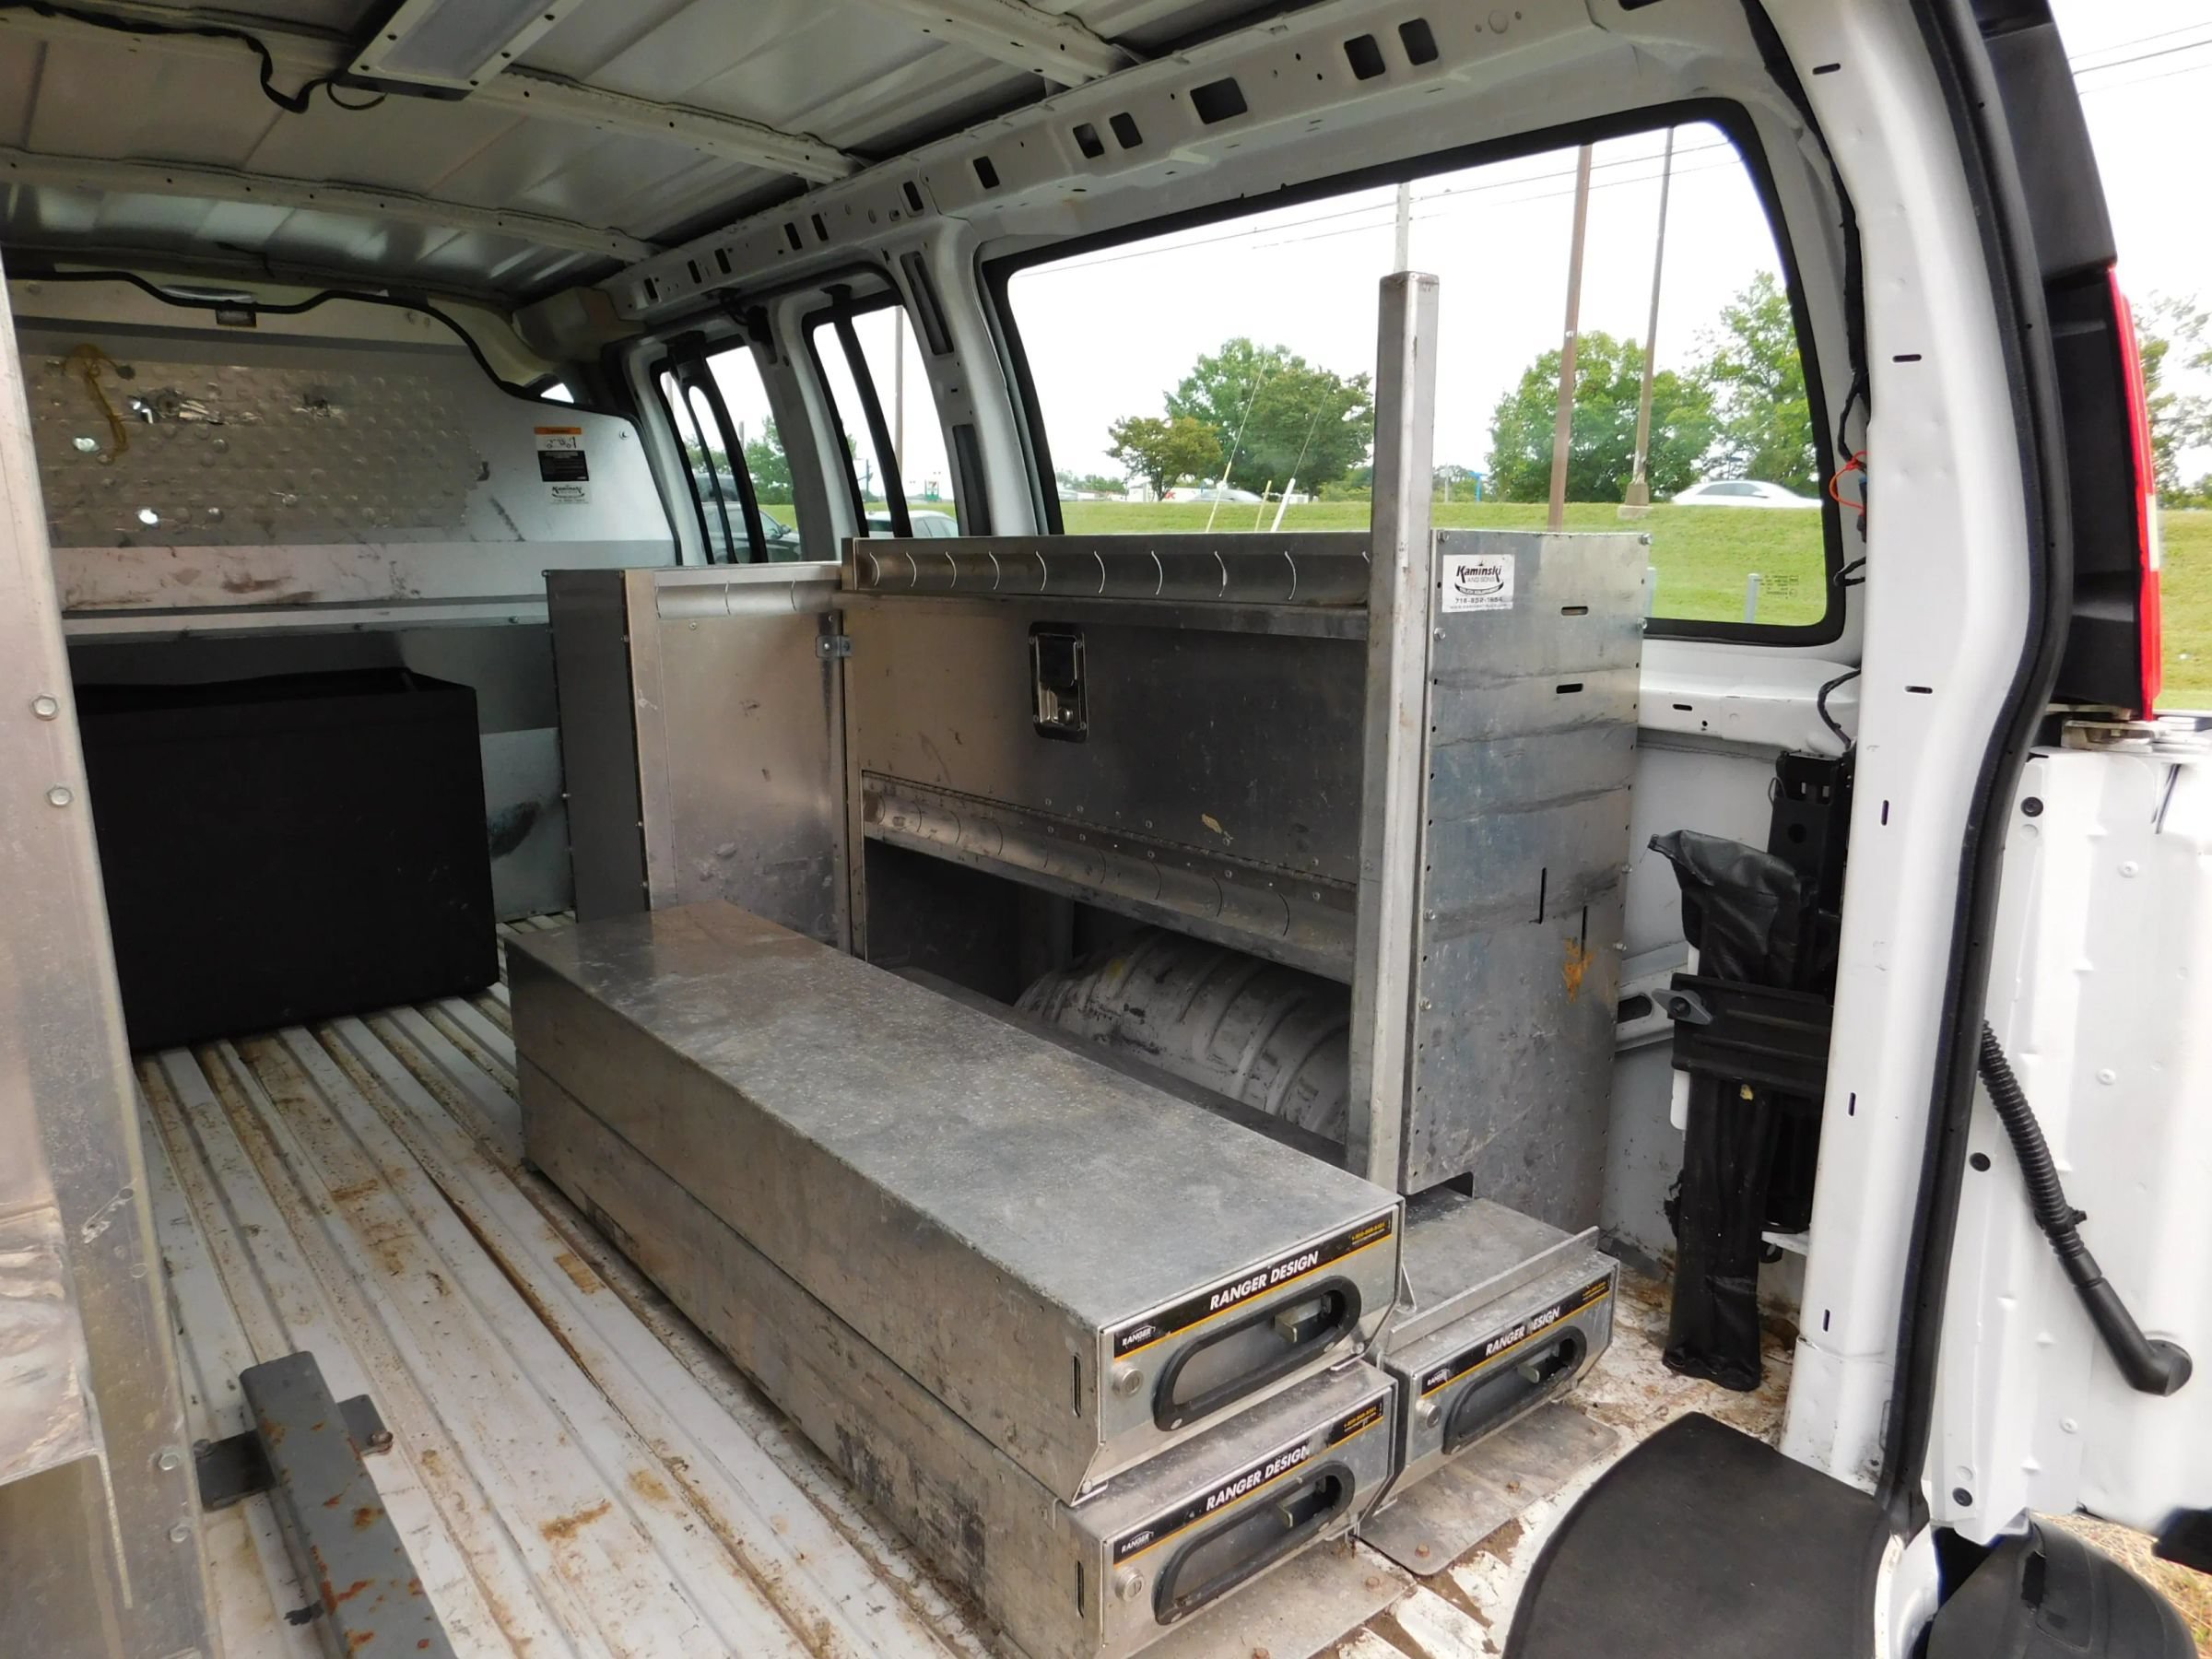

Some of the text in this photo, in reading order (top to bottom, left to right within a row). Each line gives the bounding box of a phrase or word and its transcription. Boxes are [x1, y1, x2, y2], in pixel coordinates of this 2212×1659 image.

[1456, 565, 1502, 583] Kaminski
[1209, 1251, 1319, 1311] RANGER DESIGN
[1122, 1327, 1152, 1347] RANGER
[1486, 1306, 1560, 1357] RANGER ESIGN
[1206, 1445, 1312, 1512] RANGER DESIGN
[1121, 1533, 1150, 1555] RANGER
